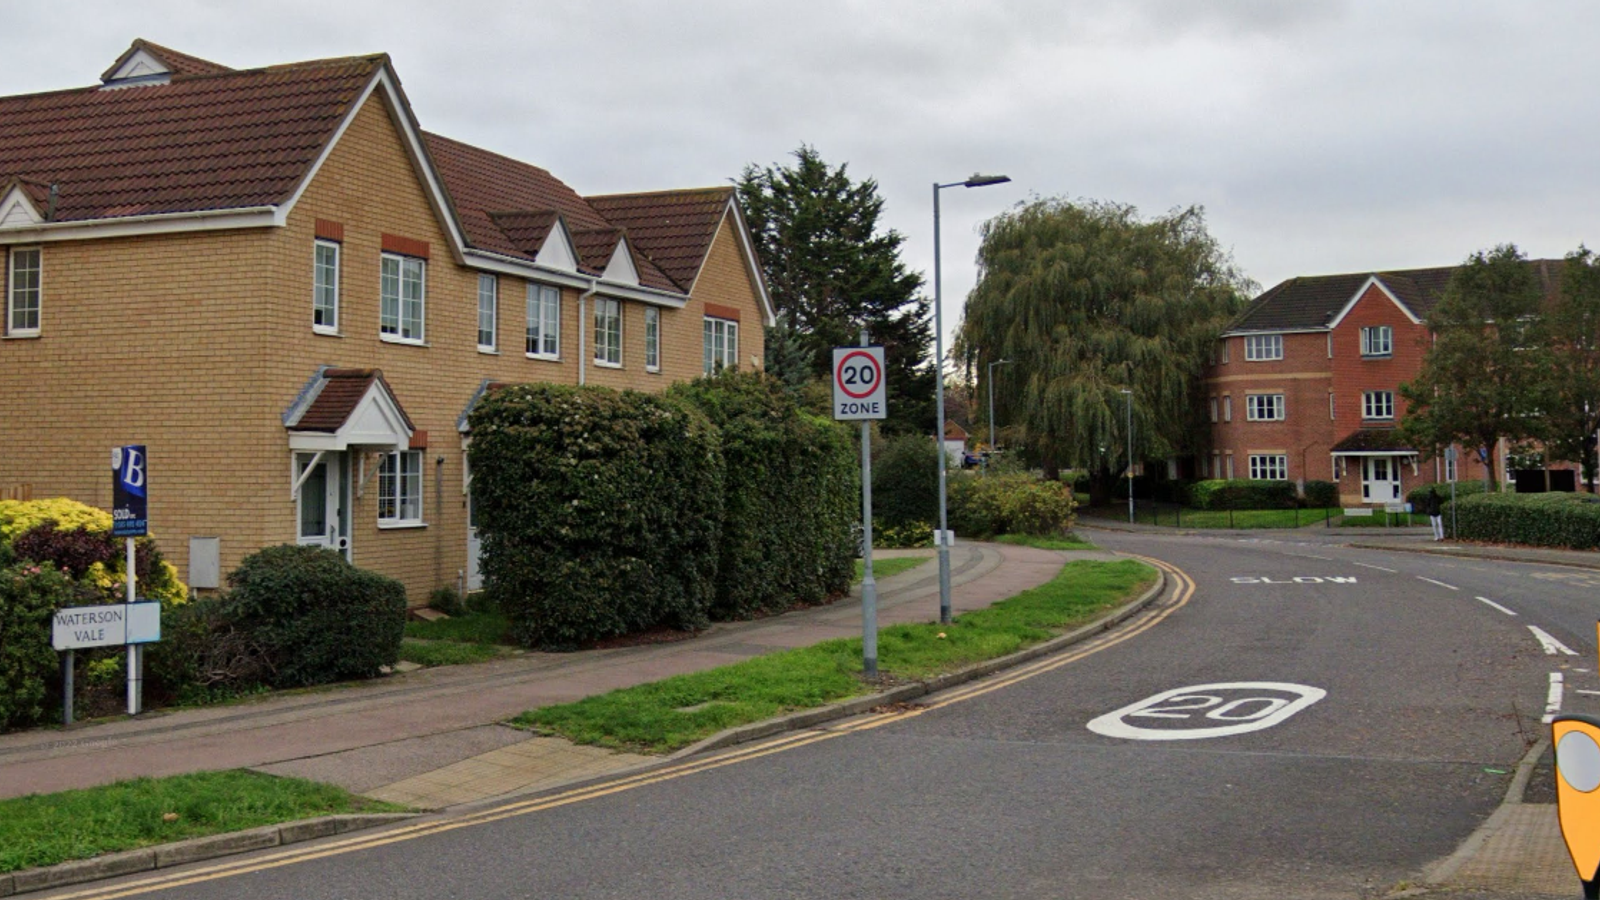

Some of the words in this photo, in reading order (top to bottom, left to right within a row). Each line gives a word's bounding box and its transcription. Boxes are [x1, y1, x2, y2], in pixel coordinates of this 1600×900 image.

[844, 365, 874, 385] 20
[840, 402, 880, 415] ZONE
[123, 448, 145, 487] B
[1229, 576, 1358, 584] SLOW
[55, 609, 123, 627] WATERSON
[74, 628, 105, 642] VALE
[1129, 695, 1290, 721] 20
